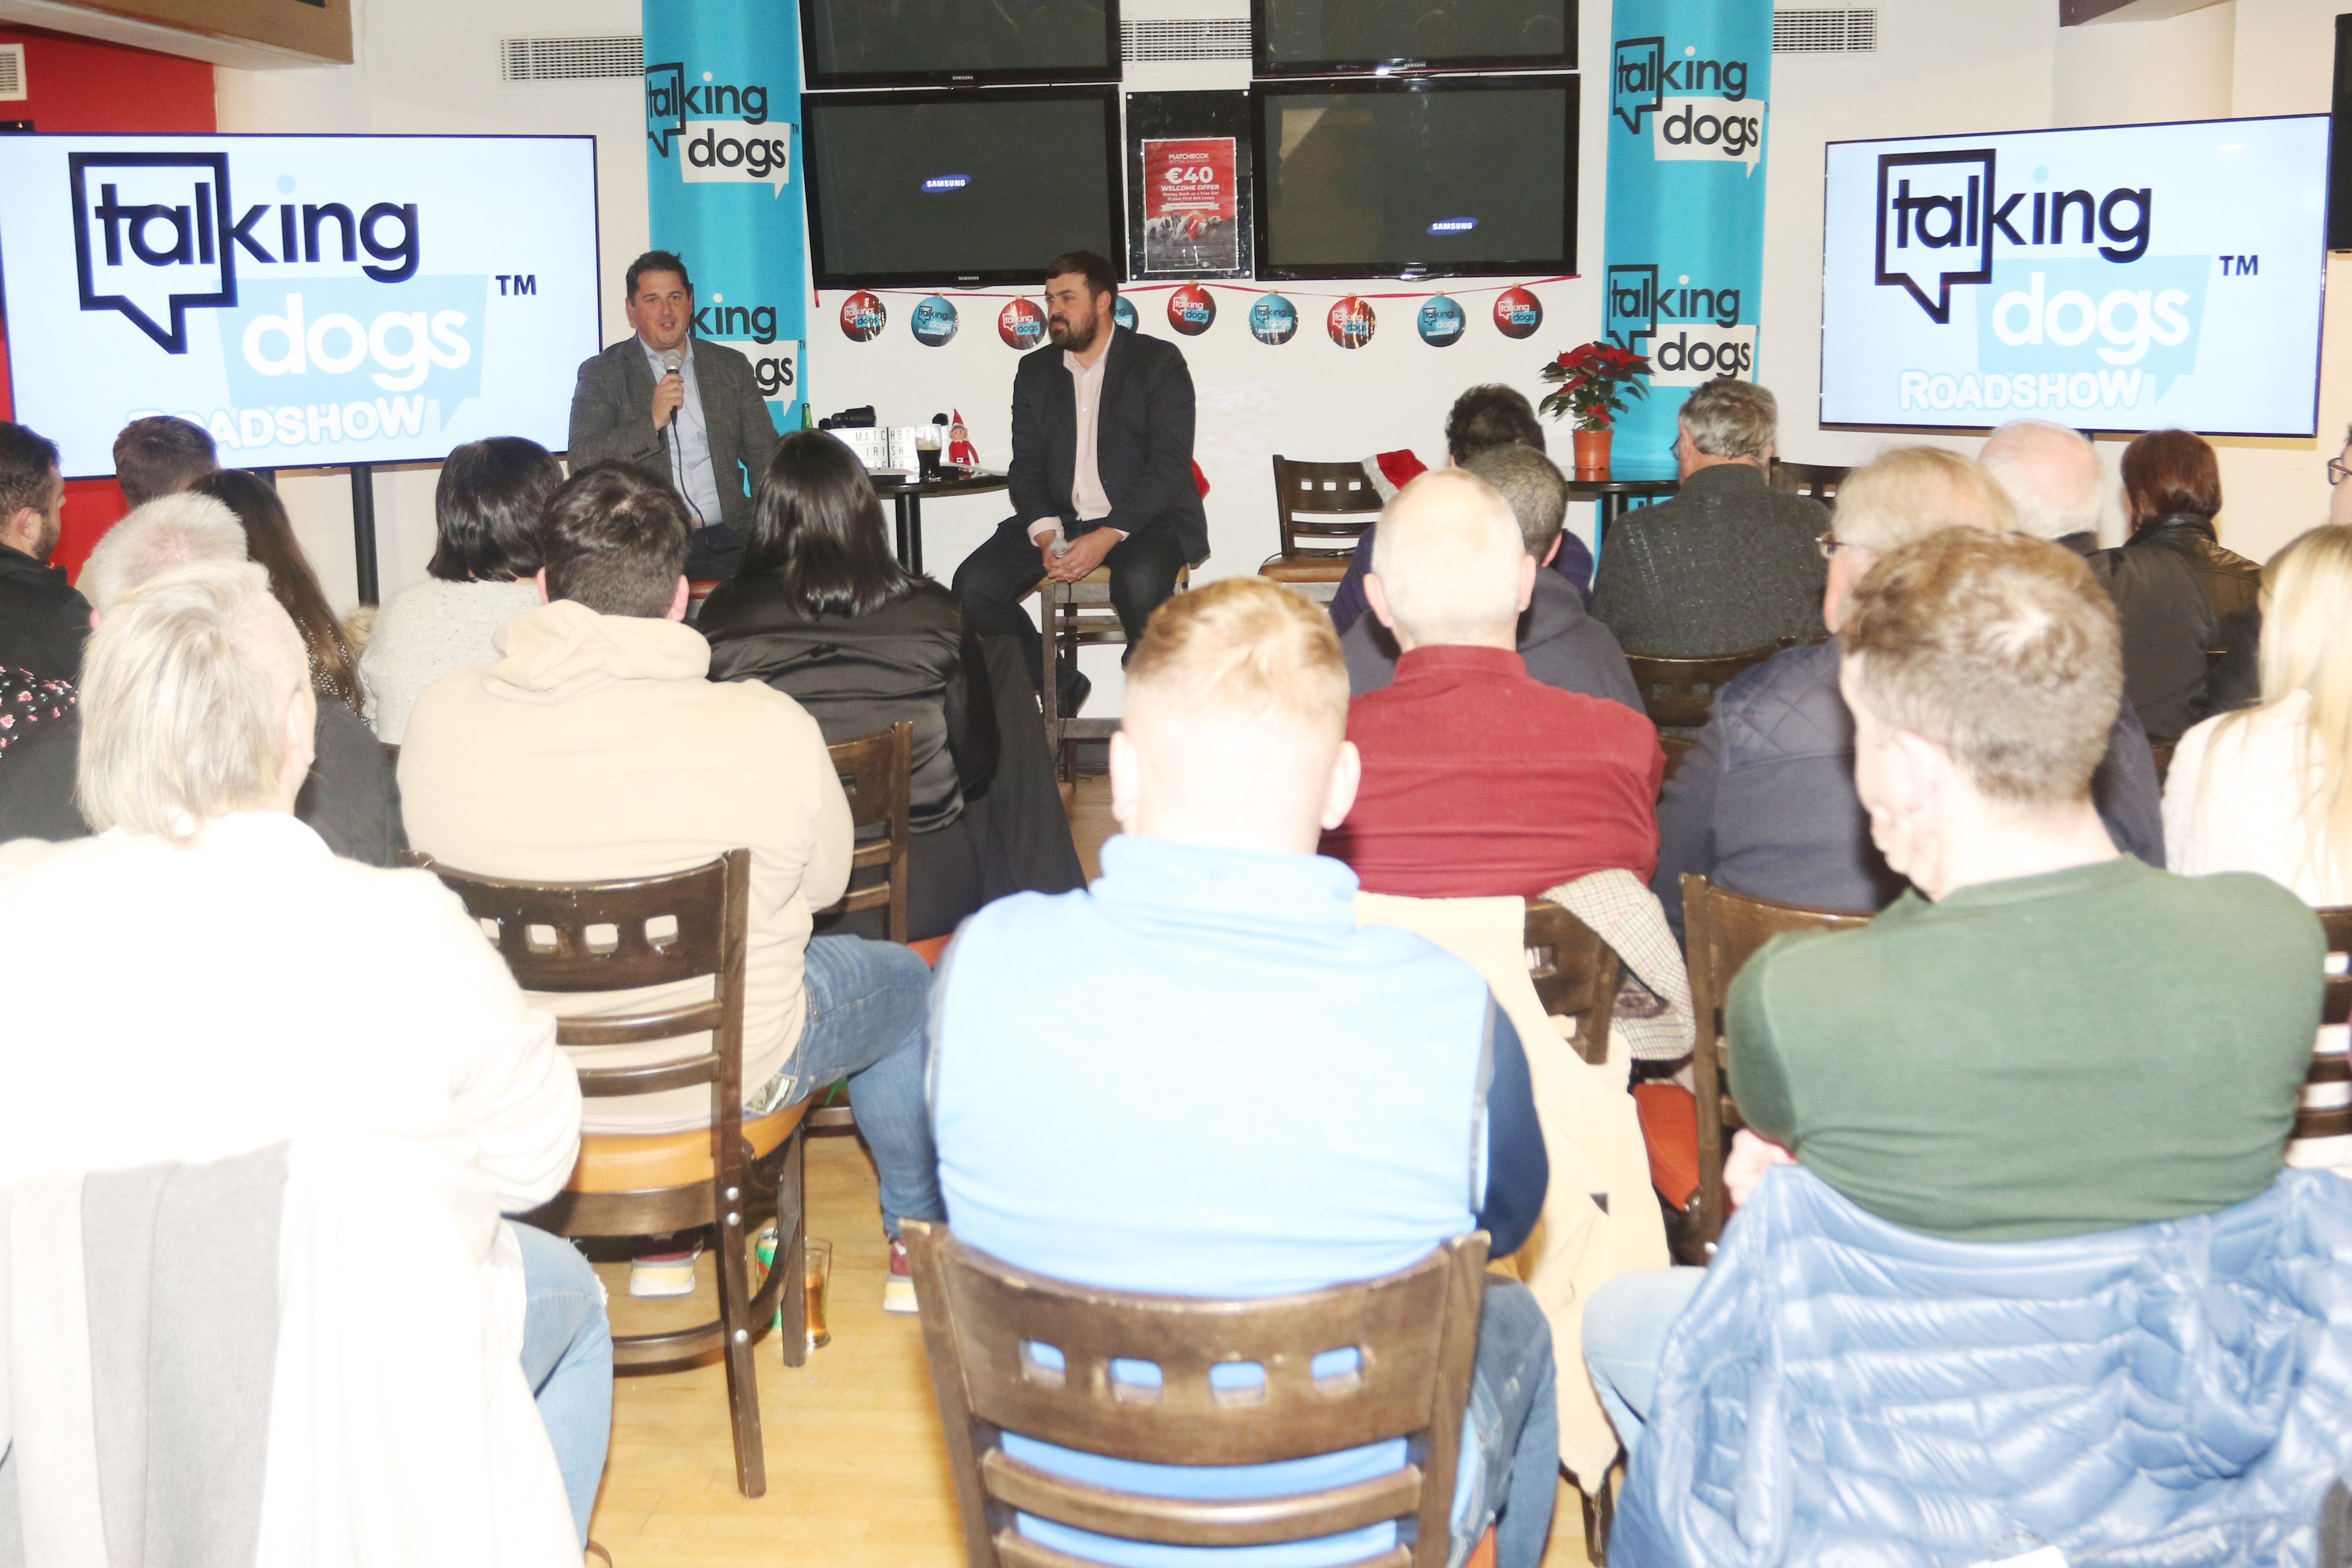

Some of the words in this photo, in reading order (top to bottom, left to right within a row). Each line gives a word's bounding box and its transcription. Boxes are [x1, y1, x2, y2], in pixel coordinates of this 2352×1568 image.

[1619, 46, 1748, 102] talking
[649, 71, 768, 124] talking
[1663, 104, 1759, 156] dogs
[688, 128, 786, 177] dogs
[1165, 166, 1214, 185] €40
[927, 179, 966, 188] SAMSUNG
[1893, 166, 2152, 263] talking
[95, 175, 420, 283] talking
[1433, 221, 1473, 230] SAMSUNG
[2219, 255, 2259, 276] TM
[495, 274, 537, 296] TM
[1175, 299, 1204, 310] talking
[1500, 302, 1529, 312] talking
[1612, 275, 1740, 328] talking
[846, 307, 875, 316] talking
[920, 309, 948, 320] talking
[1186, 310, 1207, 320] dogs
[1258, 308, 1286, 317] talking
[1335, 312, 1363, 322] talking
[1425, 309, 1454, 319] talking
[690, 293, 777, 345] king
[1005, 314, 1034, 323] talking
[1114, 318, 1131, 327] ogs
[1269, 318, 1290, 327] dogs
[1437, 317, 1458, 329] dogs
[1514, 312, 1535, 323] dogs
[1992, 272, 2190, 365] dogs
[929, 320, 951, 331] dogs
[1018, 324, 1038, 333] dogs
[1347, 322, 1367, 332] dogs
[242, 293, 471, 391] dogs
[1658, 332, 1750, 379] dogs
[755, 358, 794, 396] gs
[1900, 370, 2142, 410] ROADSHOW
[129, 393, 424, 449] ADSHOW
[867, 445, 903, 456] IRISH
